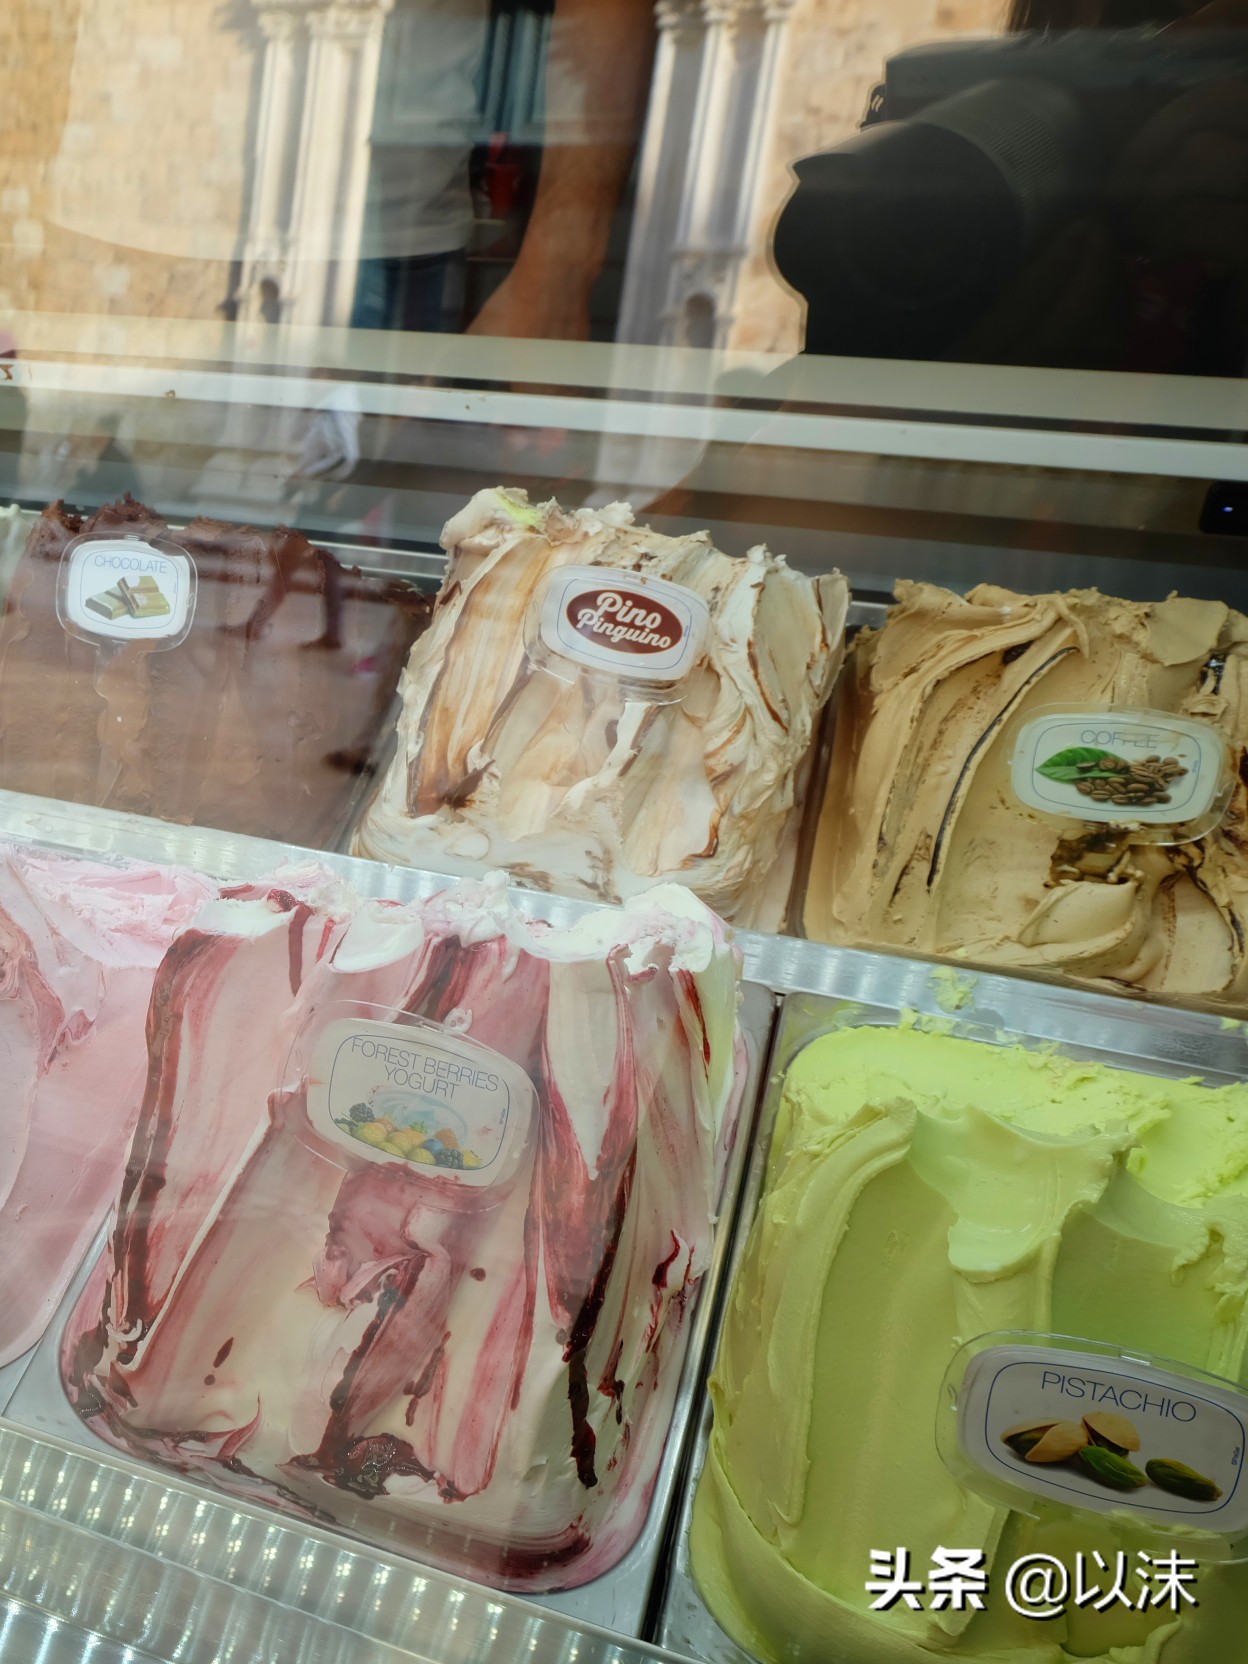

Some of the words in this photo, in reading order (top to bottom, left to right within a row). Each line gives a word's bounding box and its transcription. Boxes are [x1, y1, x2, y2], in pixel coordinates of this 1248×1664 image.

[94, 555, 167, 573] CHOCOLATE
[576, 609, 671, 648] Pinguino
[596, 592, 662, 629] Pino
[1080, 730, 1160, 748] COFFEE
[352, 1037, 421, 1069] FOREST
[423, 1057, 499, 1091] BERRIES
[384, 1064, 460, 1099] YOGURT
[1041, 1371, 1197, 1422] PISTACHIO
